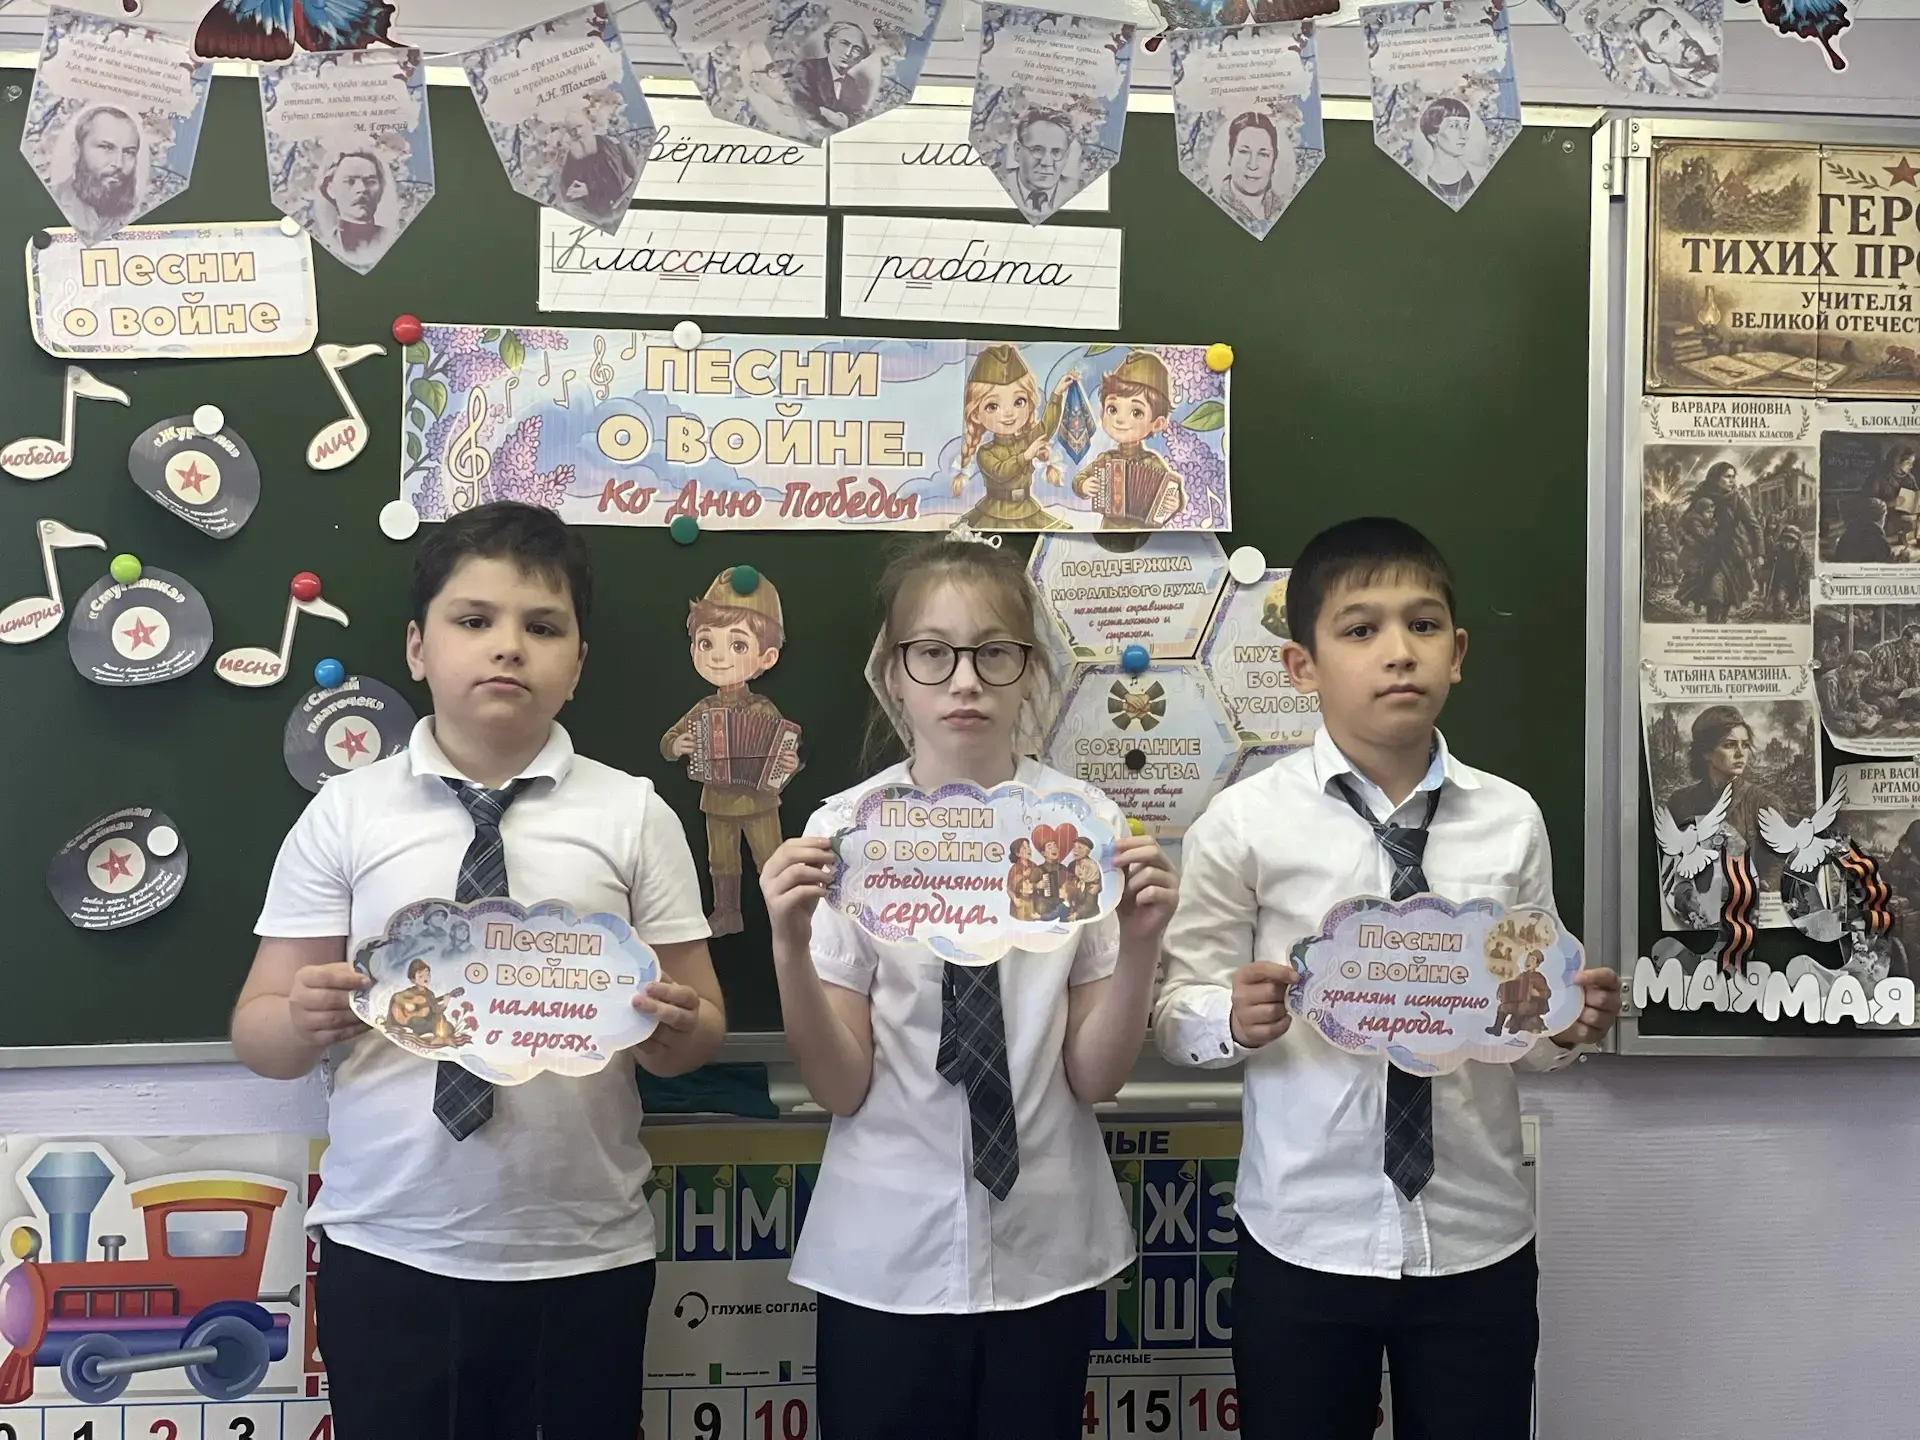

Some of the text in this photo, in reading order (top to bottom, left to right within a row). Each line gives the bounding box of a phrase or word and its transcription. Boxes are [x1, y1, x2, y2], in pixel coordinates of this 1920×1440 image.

[648, 125, 986, 183] вёртое ма
[1817, 193, 1920, 237] ГЕР
[80, 247, 256, 287] Песни
[1682, 238, 1920, 279] ТИХИХ ПР
[63, 291, 281, 337] о войне
[1802, 291, 1912, 312] УЧИТЕЛЯ
[1731, 311, 1829, 331] ВЕЛИКОЙ
[645, 344, 881, 397] ПЕСНИ
[1672, 401, 1792, 415] ВАРВАРА ИОНОВНА
[1693, 416, 1770, 428] КАСАТКИНА.
[314, 425, 357, 463] мир
[596, 402, 924, 467] О ВОЙНЕ.
[1668, 429, 1705, 438] УЧИТЕЛЬ
[1, 446, 70, 467] победа
[598, 472, 919, 523] Ко Дню Победы
[1062, 556, 1192, 578] ПОДДЕРЖКА
[1051, 582, 1207, 601] МОРАЛЬНОГО ДУХА
[1830, 585, 1872, 596] УЧИТЕЛЯ
[218, 657, 281, 678] песня
[1234, 645, 1281, 663] МУЗ
[1247, 670, 1292, 688] БОЕ
[1664, 668, 1792, 682] ТАТЬЯНА БАРАМЗИНА.
[1680, 684, 1723, 694] УЧИТЕЛЬ
[1234, 695, 1321, 714] УСЛОВИ
[1075, 738, 1201, 757] СОЗДАНИЕ
[1860, 767, 1920, 780] ВЕРА ВАСИ
[1872, 782, 1920, 793] АРТАМО
[880, 800, 994, 829] Песни
[863, 832, 1005, 863] о войне
[864, 866, 1003, 892] объединяют
[879, 892, 999, 935] сердца.
[485, 922, 602, 956] Песни
[1359, 924, 1462, 953] Песни
[465, 962, 488, 985] о
[1340, 956, 1469, 984] о войне
[1633, 957, 1771, 1013] МАЯ
[1763, 971, 1916, 1026] МАЯ
[489, 998, 598, 1020] память
[1321, 989, 1489, 1014] хранят историю
[1358, 1011, 1454, 1042] народа.
[486, 1029, 598, 1057] о героях.
[683, 1186, 787, 1252] Н М
[1145, 1181, 1196, 1244] Ж
[711, 1302, 817, 1315] ГЛУХИЕ СОГЛАС
[1144, 1277, 1195, 1341] Ш
[1089, 1354, 1151, 1365] ГЛАСНЫЕ
[694, 1402, 722, 1440] 9
[755, 1398, 808, 1440] 10
[1083, 1391, 1100, 1434] 4
[1117, 1389, 1171, 1433] 15
[1189, 1388, 1239, 1432] 16
